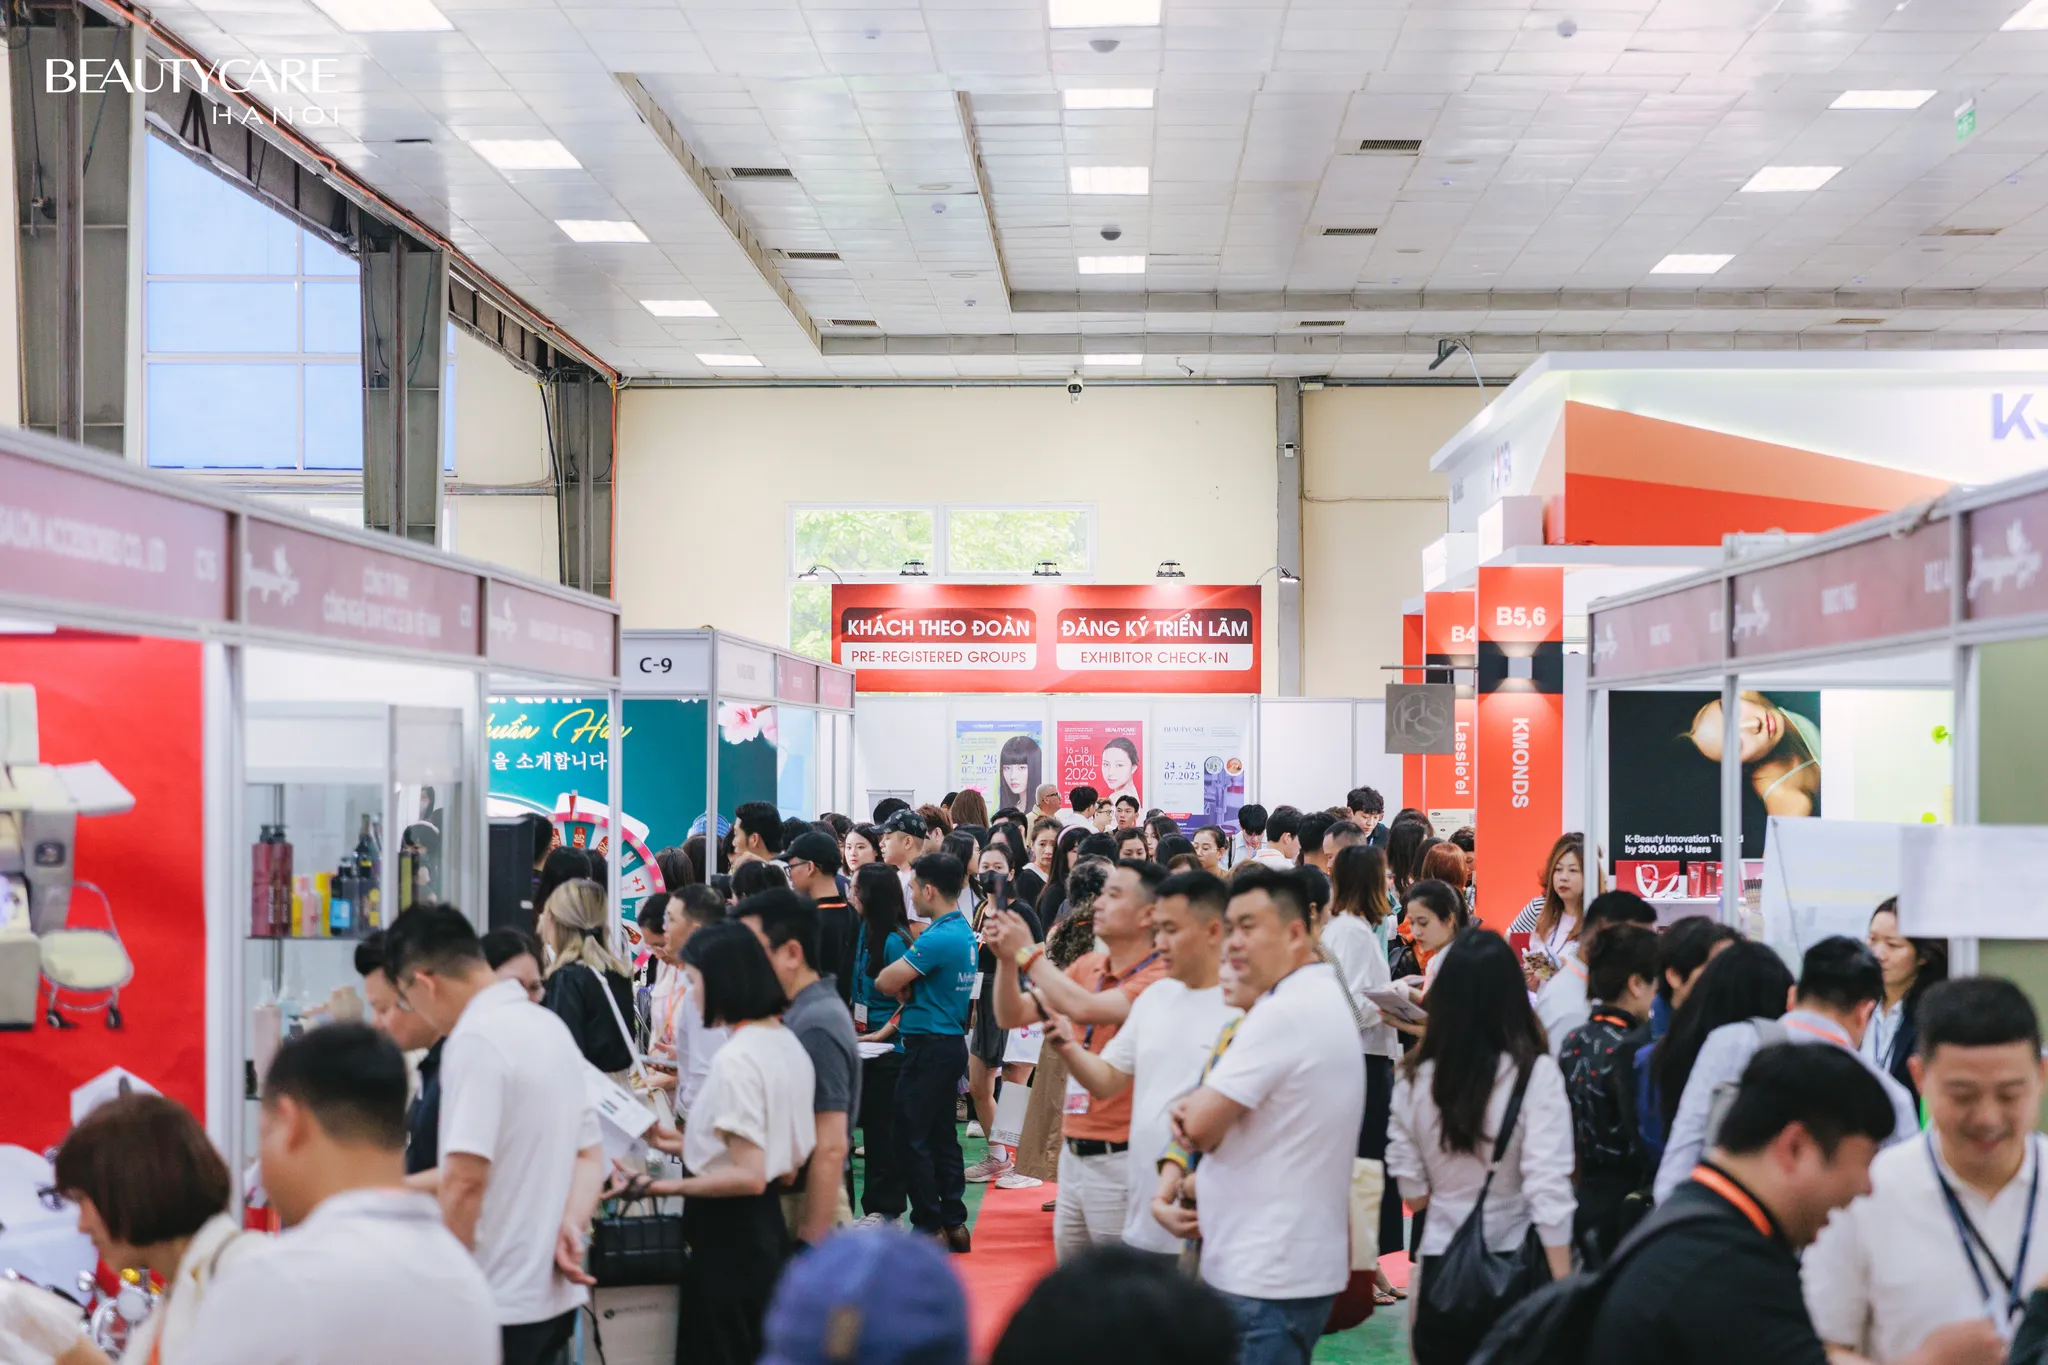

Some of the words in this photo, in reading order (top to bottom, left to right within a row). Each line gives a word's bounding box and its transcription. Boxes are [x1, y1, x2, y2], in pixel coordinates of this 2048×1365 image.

[1496, 606, 1546, 629] B5,6
[848, 614, 914, 636] KHÁCH
[919, 620, 967, 637] THEO
[971, 615, 1030, 637] ĐOÀN
[1060, 616, 1121, 637] ĐĂNG
[1125, 615, 1150, 637] KÝ
[1153, 613, 1201, 637] TRIỂN
[1208, 617, 1248, 637] LÃM
[851, 650, 963, 663] PRE-REGISTERED
[967, 651, 1027, 663] GROUPS
[1080, 651, 1153, 663] EXHIBITOR
[1157, 651, 1229, 664] CHECK-IN
[639, 657, 673, 673] C-9
[1065, 746, 1074, 754] 16
[1081, 746, 1089, 754] 18
[516, 751, 608, 771] 소개합니다
[961, 754, 975, 765] 24
[984, 754, 998, 765] 26
[1064, 755, 1098, 767] APRIL
[1454, 721, 1470, 795] Lassie'el
[1512, 717, 1530, 809] KMONDS
[1164, 761, 1175, 769] 24
[1185, 761, 1196, 769] 26
[1065, 767, 1097, 780] 2026
[1164, 771, 1200, 780] 07.2025
[1624, 834, 1664, 844] K-Beauty
[1665, 834, 1710, 843] Innovation
[1624, 844, 1636, 855] by
[1637, 844, 1684, 855] 300,000+
[1685, 844, 1712, 854] Users
